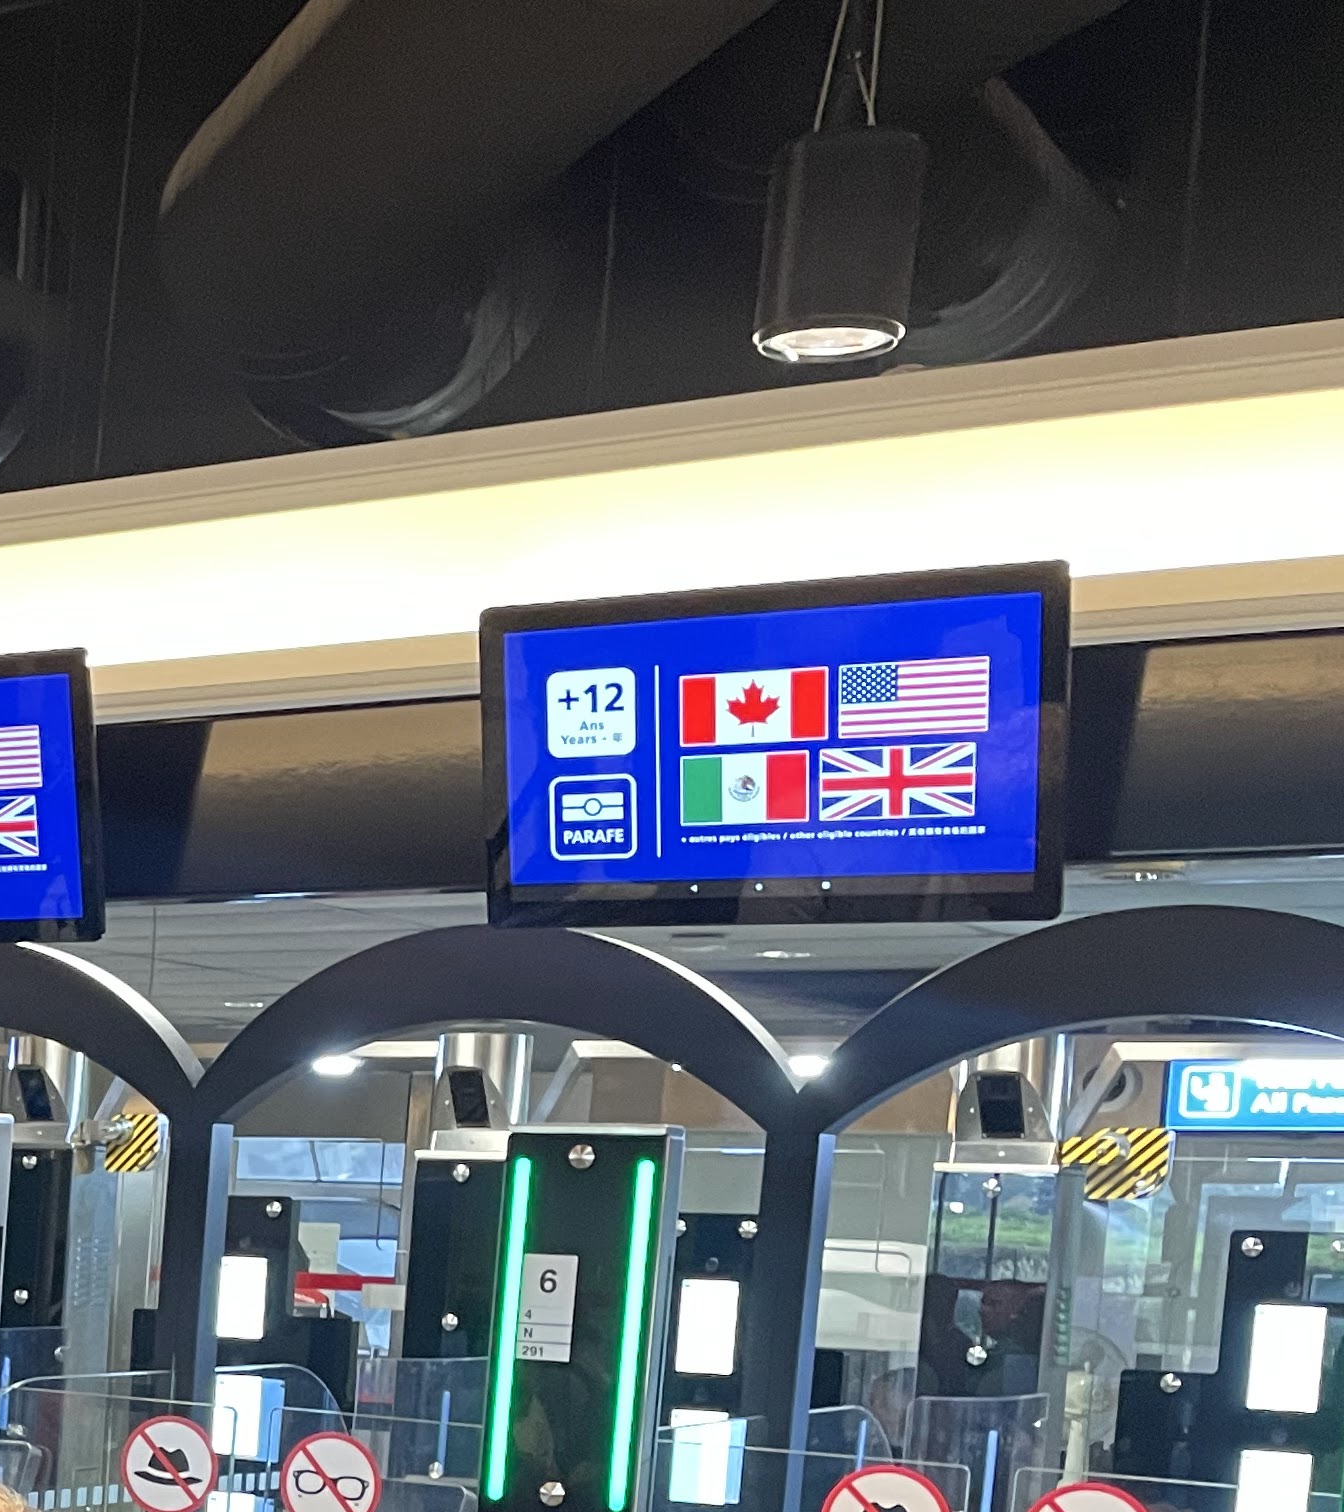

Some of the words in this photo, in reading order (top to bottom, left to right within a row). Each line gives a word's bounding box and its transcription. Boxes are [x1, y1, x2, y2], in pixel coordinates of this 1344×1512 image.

[558, 682, 624, 713] +12
[579, 721, 605, 731] Ans
[561, 734, 597, 745] Years
[563, 828, 625, 845] PARAFE
[719, 835, 740, 845] pays
[789, 831, 815, 840] other
[817, 830, 853, 841] eligible
[854, 829, 899, 838] countries
[539, 1268, 558, 1293] 6
[524, 1309, 532, 1320] 4
[523, 1328, 533, 1338] N
[521, 1345, 544, 1357] 291
